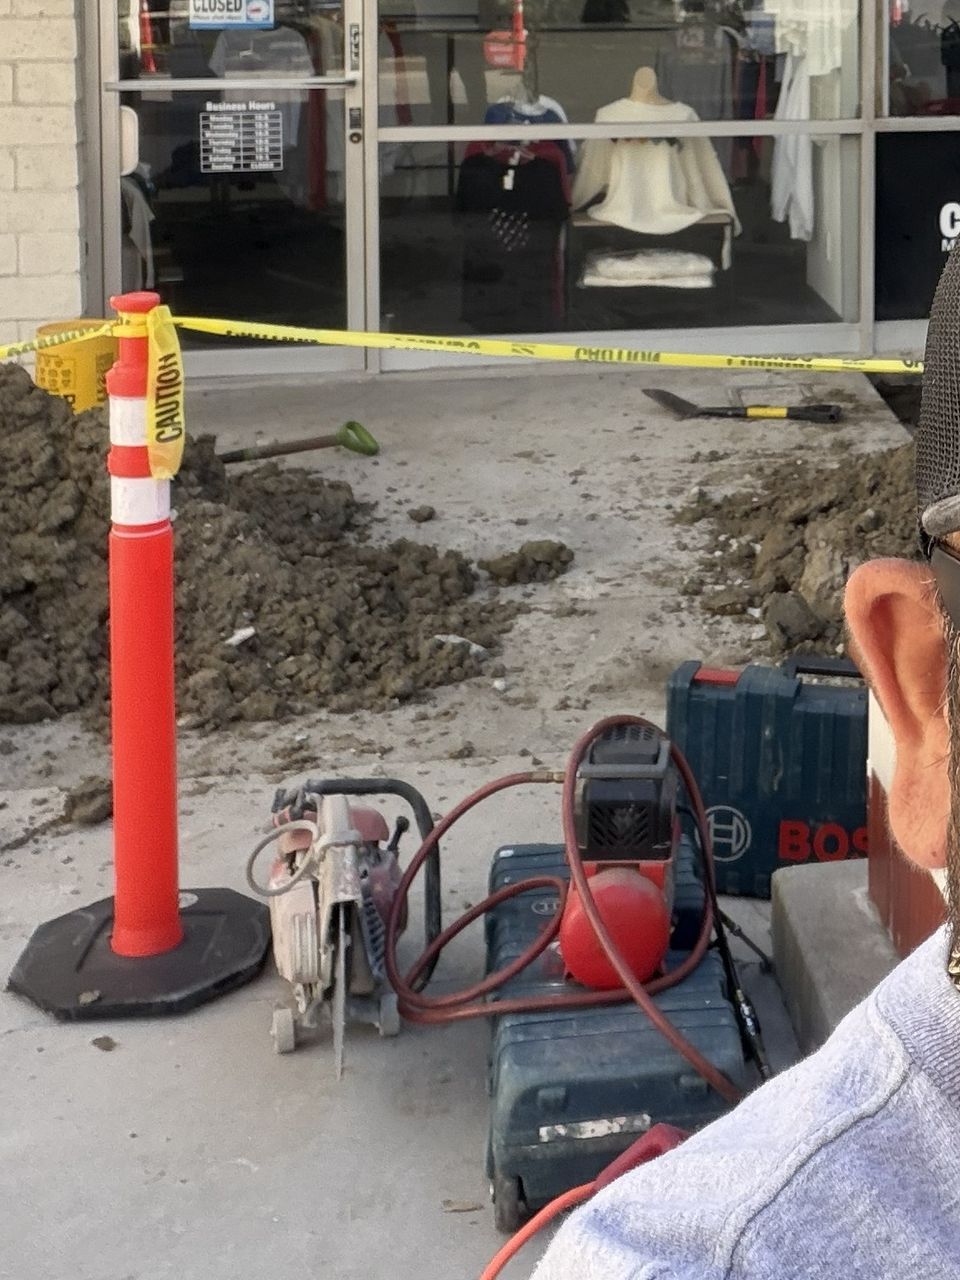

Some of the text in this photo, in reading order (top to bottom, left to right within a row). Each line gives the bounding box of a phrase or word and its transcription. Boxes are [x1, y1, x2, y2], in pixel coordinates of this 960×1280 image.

[206, 101, 275, 111] Business Hours
[155, 352, 184, 444] CAUTION
